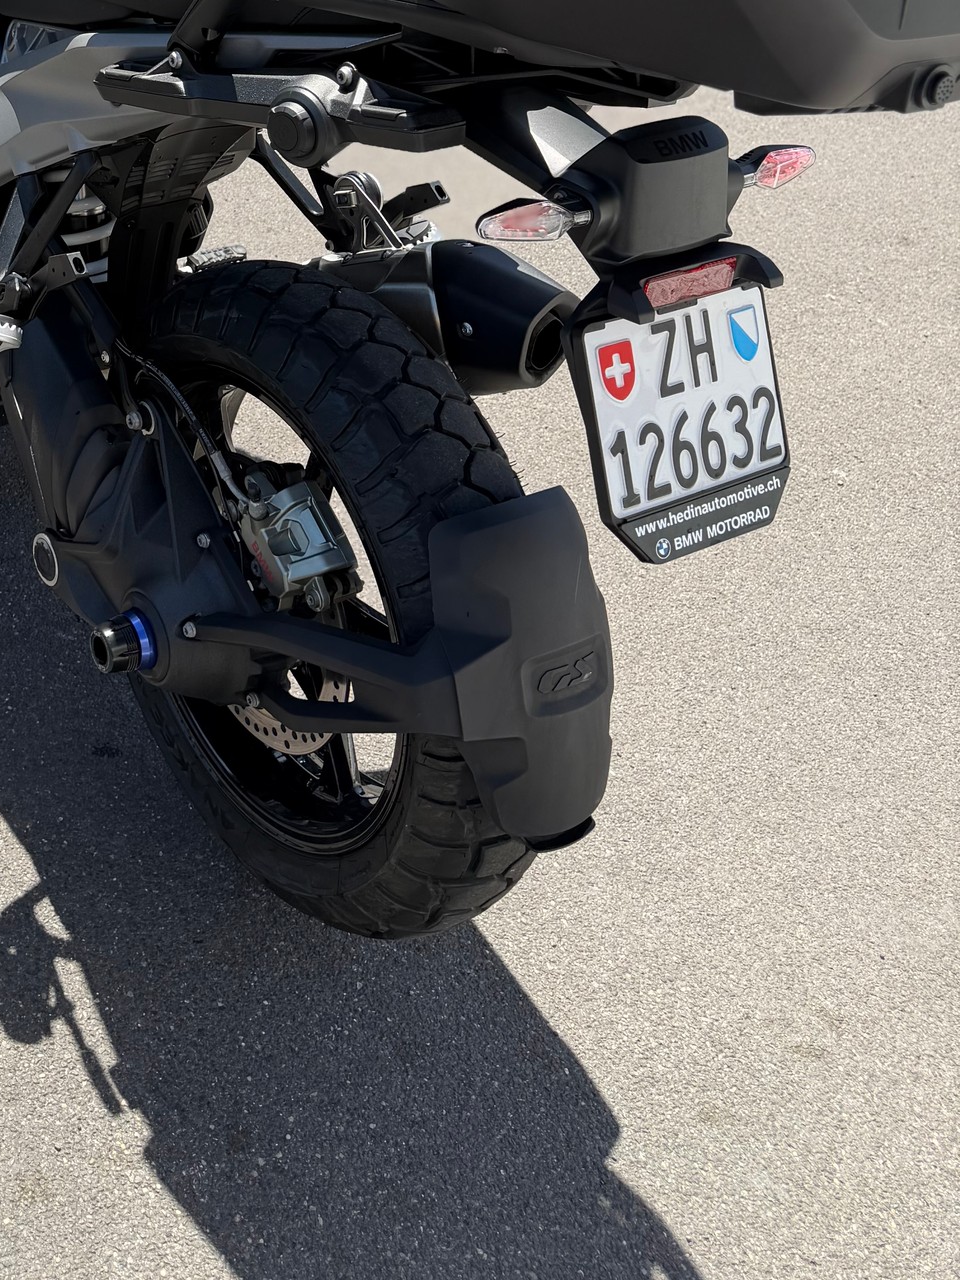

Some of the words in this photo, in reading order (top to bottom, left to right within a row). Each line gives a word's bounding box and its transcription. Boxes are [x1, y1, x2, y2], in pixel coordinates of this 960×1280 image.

[653, 130, 709, 157] BMW
[650, 308, 719, 398] ZH
[609, 386, 782, 509] 126632
[635, 476, 781, 538] www.hedinautomotive.ch
[673, 528, 703, 551] BMW
[706, 505, 771, 539] MOTORRAD
[537, 650, 594, 694] GS
